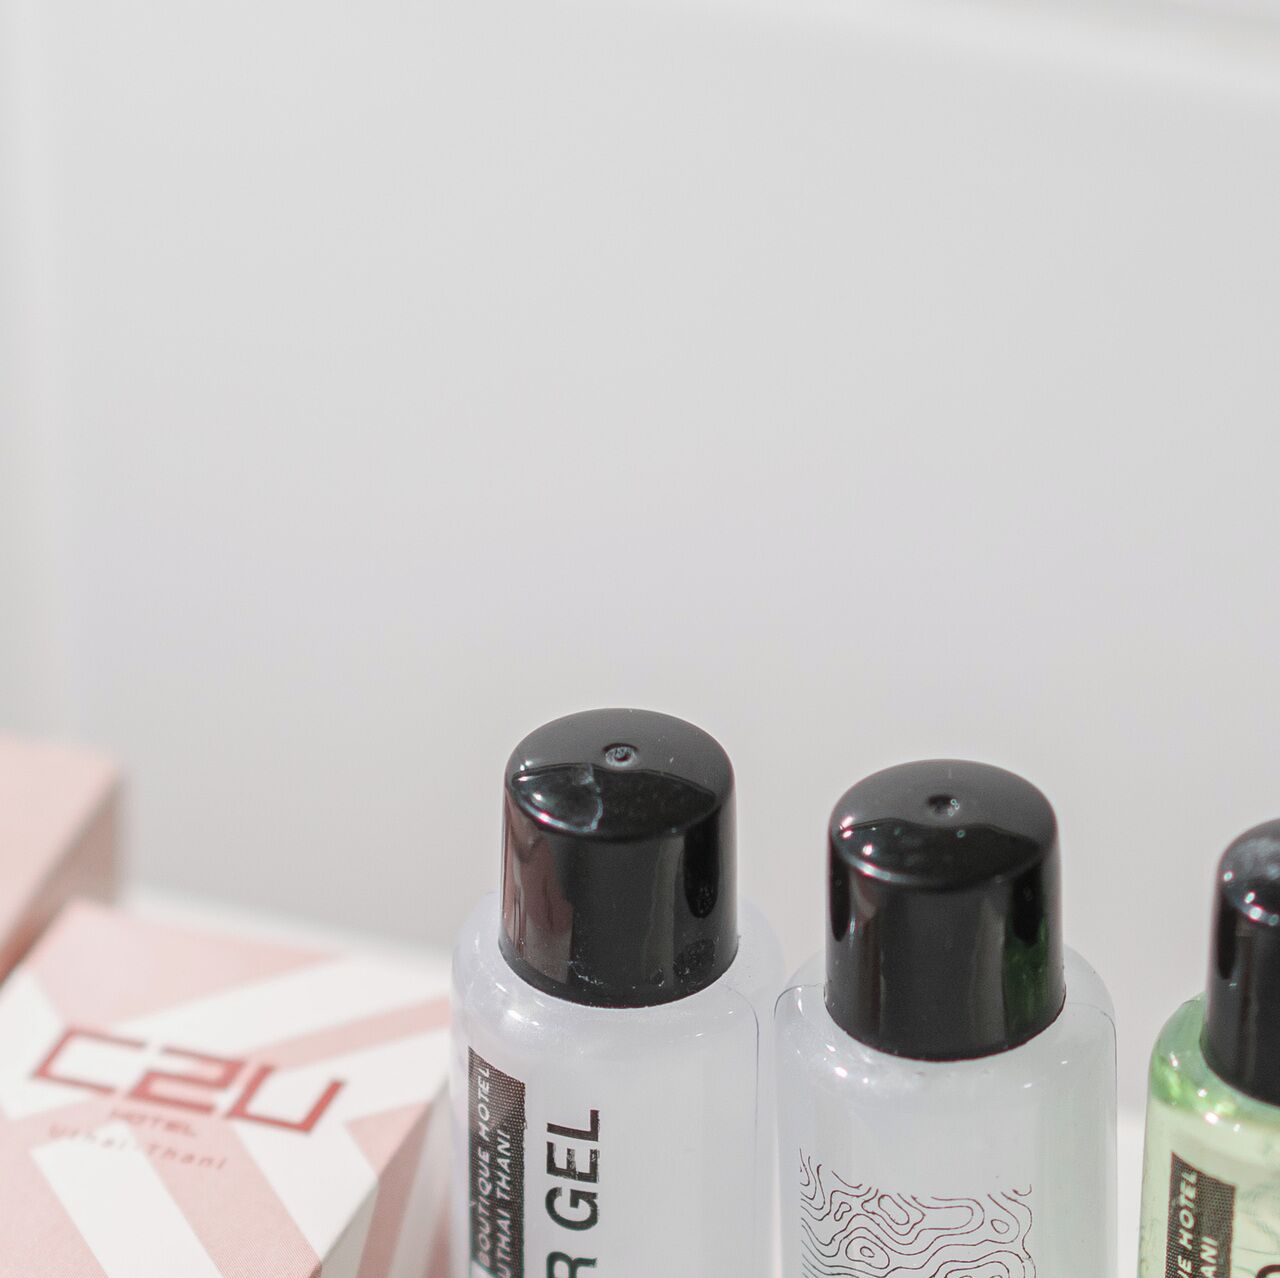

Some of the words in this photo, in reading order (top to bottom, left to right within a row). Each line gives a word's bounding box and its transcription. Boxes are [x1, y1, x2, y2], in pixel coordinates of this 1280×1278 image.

[30, 1027, 347, 1134] C2U
[477, 1067, 492, 1143] HOTEL
[477, 1145, 492, 1269] BOUTIQUE
[496, 1130, 512, 1202] THANI
[545, 1108, 601, 1232] GEL
[1178, 1170, 1199, 1251] HOTEL
